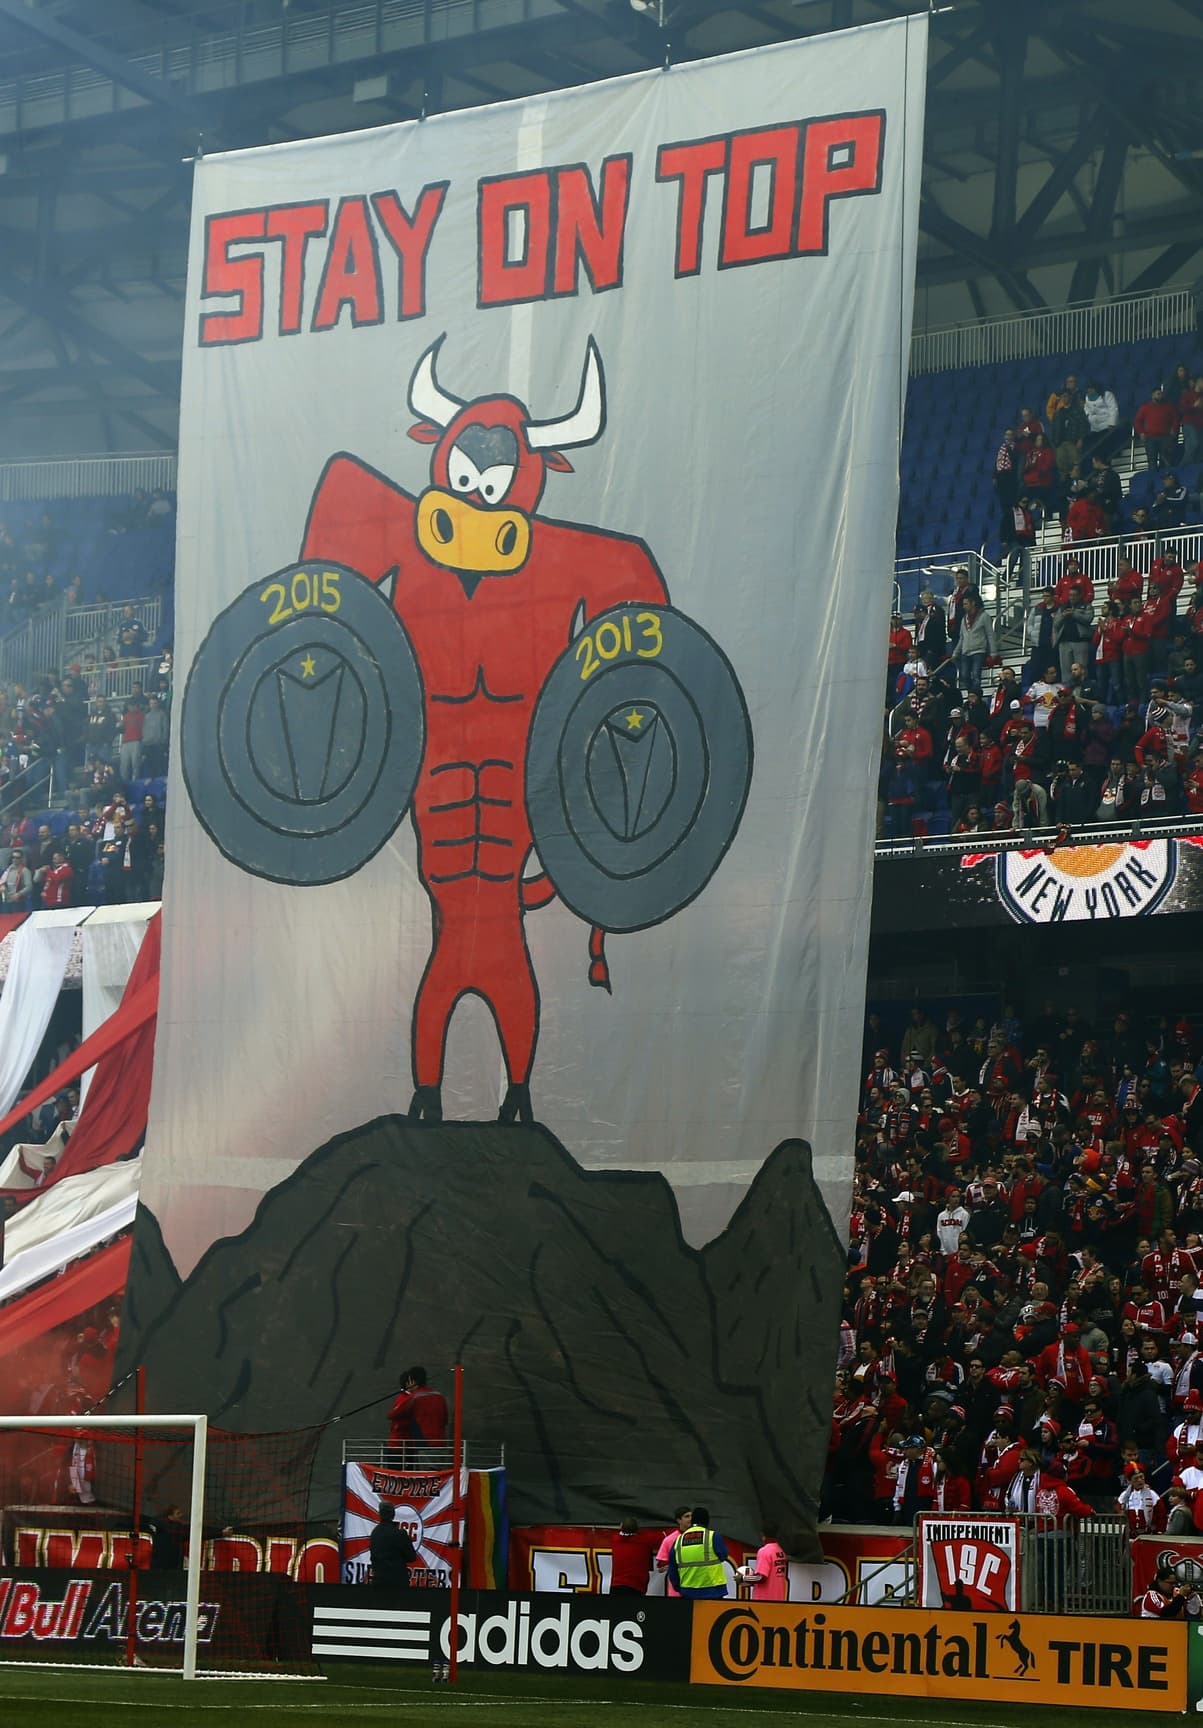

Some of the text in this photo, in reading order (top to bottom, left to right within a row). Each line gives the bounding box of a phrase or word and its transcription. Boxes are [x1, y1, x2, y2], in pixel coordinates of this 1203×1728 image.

[198, 107, 887, 348] STAY ON TOP
[260, 572, 342, 625] 2015
[575, 611, 664, 681] 2013
[1015, 855, 1158, 922] NEW YORK
[372, 1472, 442, 1497] EMPIRE
[925, 1523, 1011, 1545] INDEPENDENT
[944, 1543, 1001, 1596] ISC
[2, 1579, 93, 1640] Bull
[84, 1582, 221, 1642] Arena
[708, 1606, 991, 1682] Continental
[1048, 1639, 1169, 1691] TIRE
